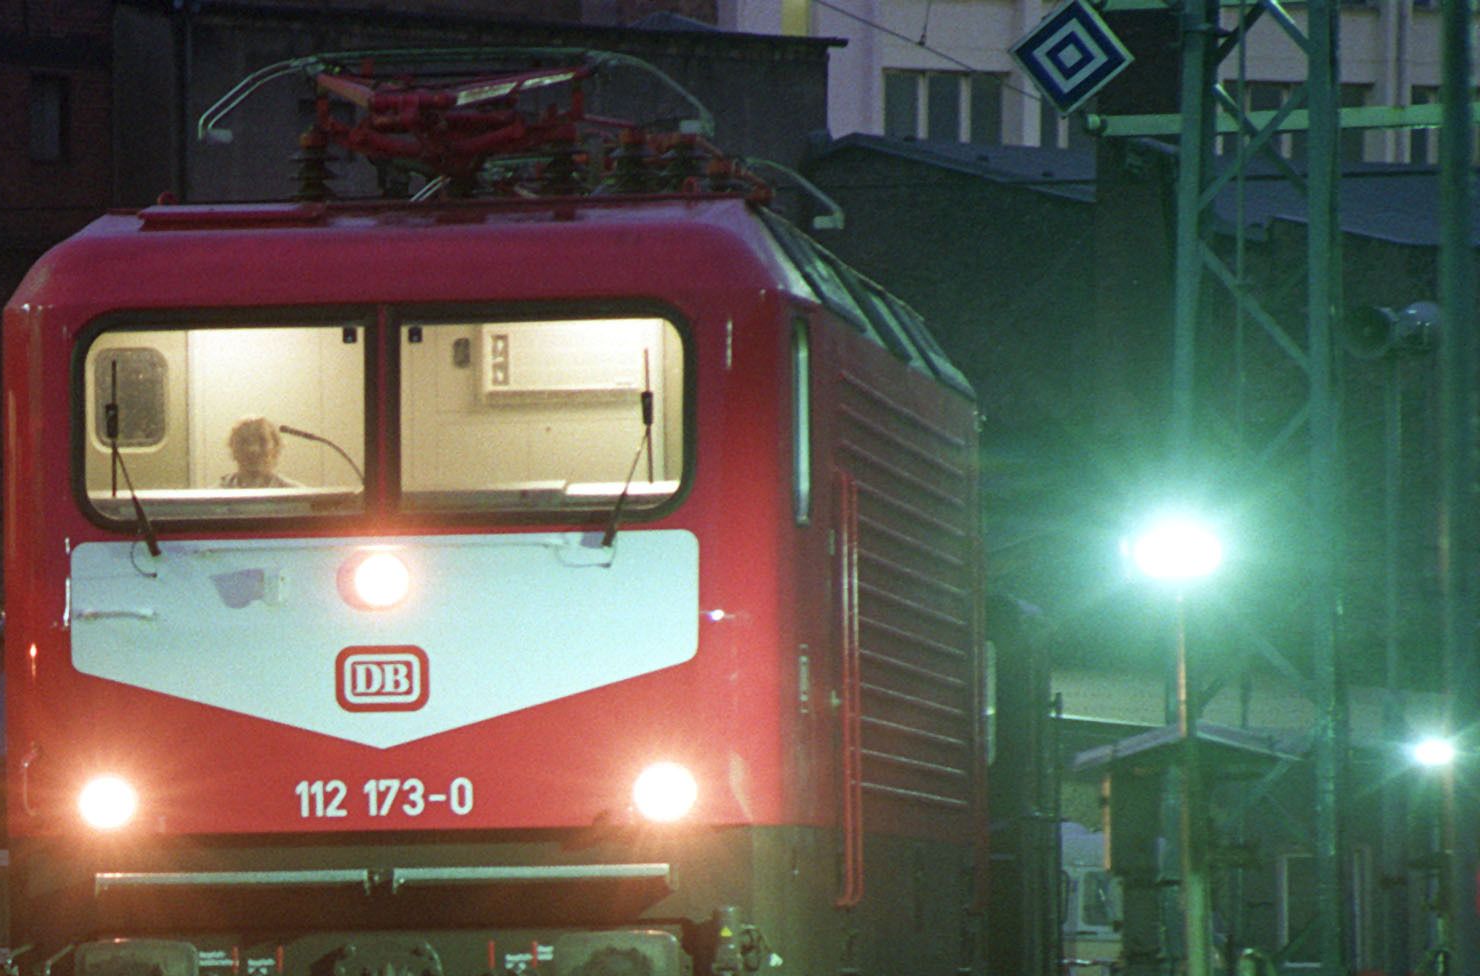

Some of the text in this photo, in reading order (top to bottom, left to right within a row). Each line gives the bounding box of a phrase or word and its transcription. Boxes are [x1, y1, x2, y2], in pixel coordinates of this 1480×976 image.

[353, 663, 411, 694] DB
[295, 777, 473, 818] 112 173-0
